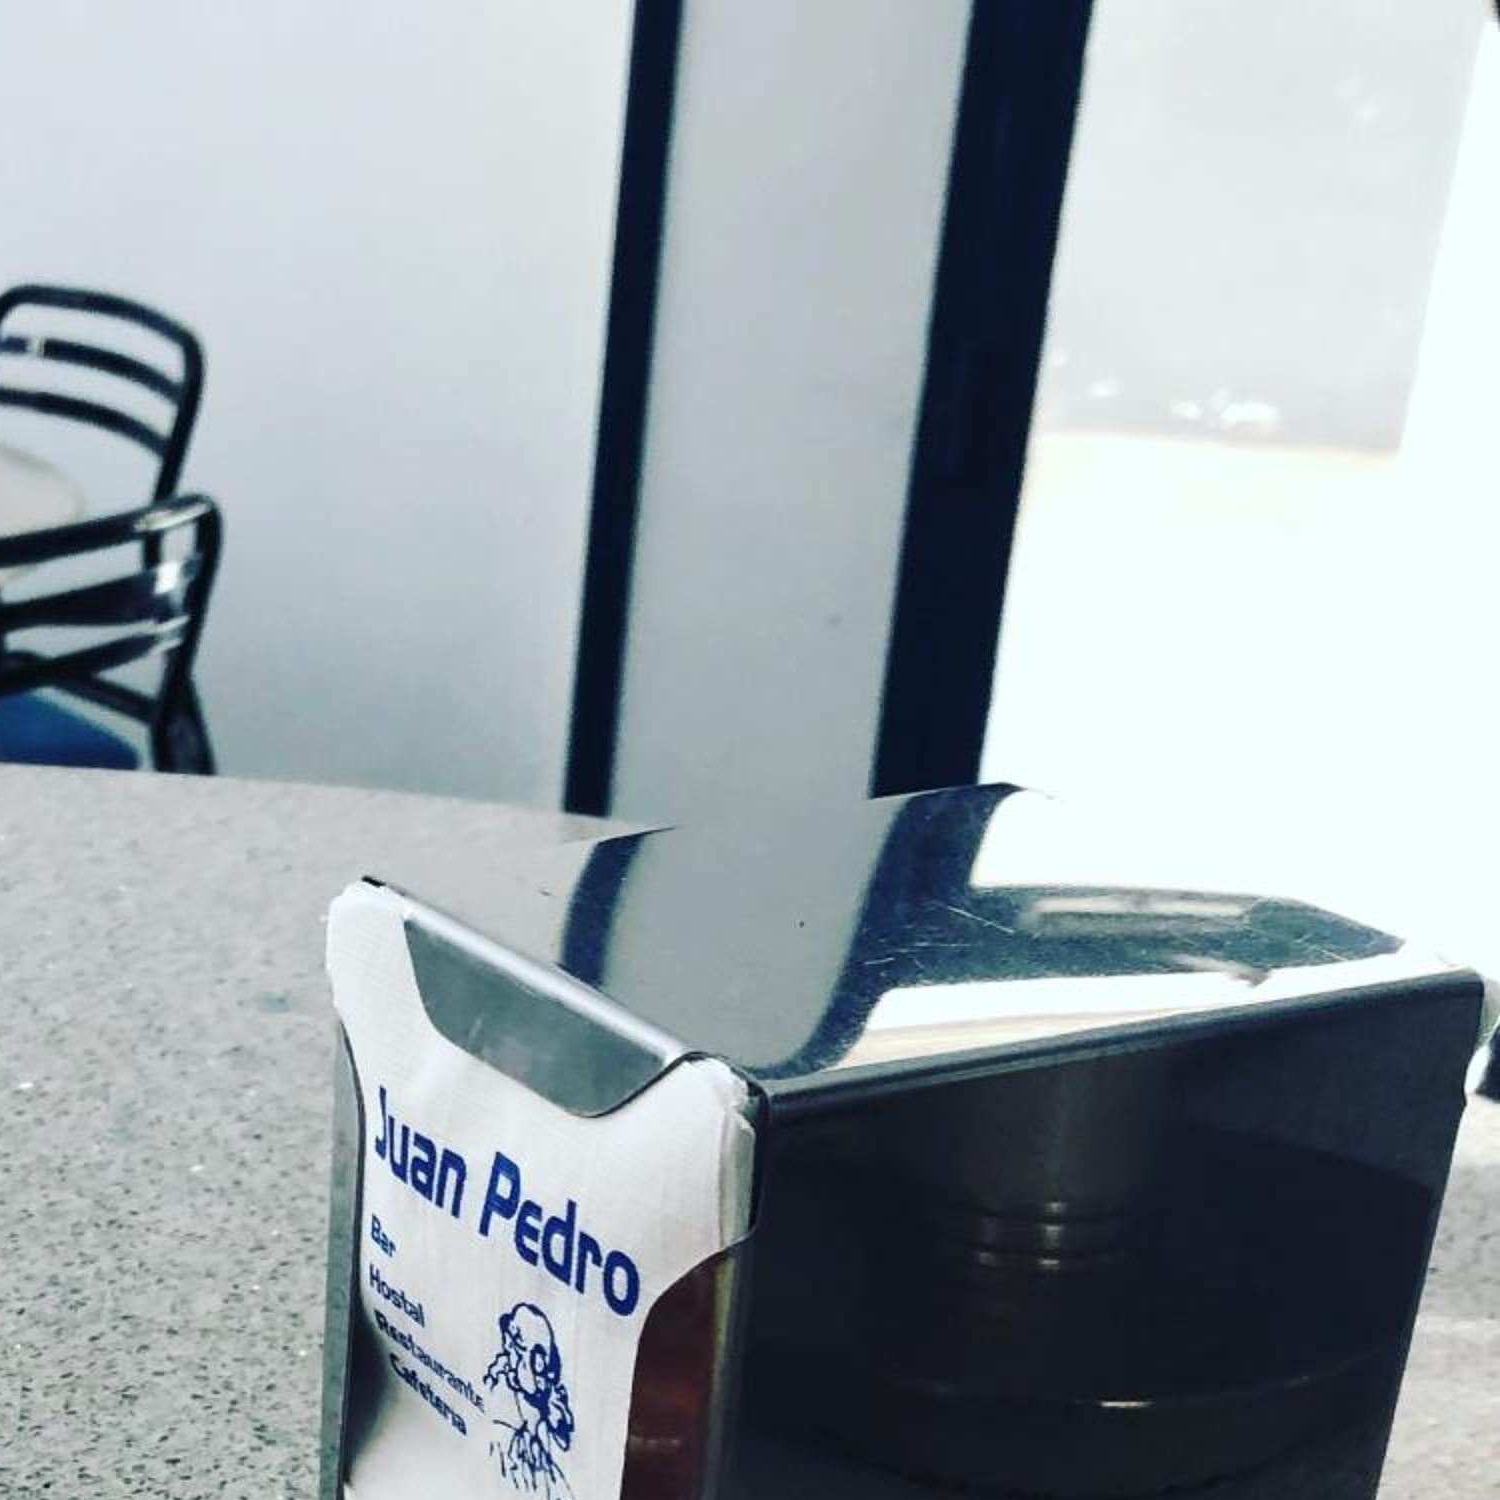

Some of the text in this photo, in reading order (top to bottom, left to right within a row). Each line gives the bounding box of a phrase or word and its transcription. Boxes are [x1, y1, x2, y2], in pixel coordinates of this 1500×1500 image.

[371, 1214, 396, 1258] Bar
[375, 1084, 641, 1316] Juan Pedro
[369, 1263, 426, 1328] Hostal
[373, 1308, 485, 1414] Restaurante
